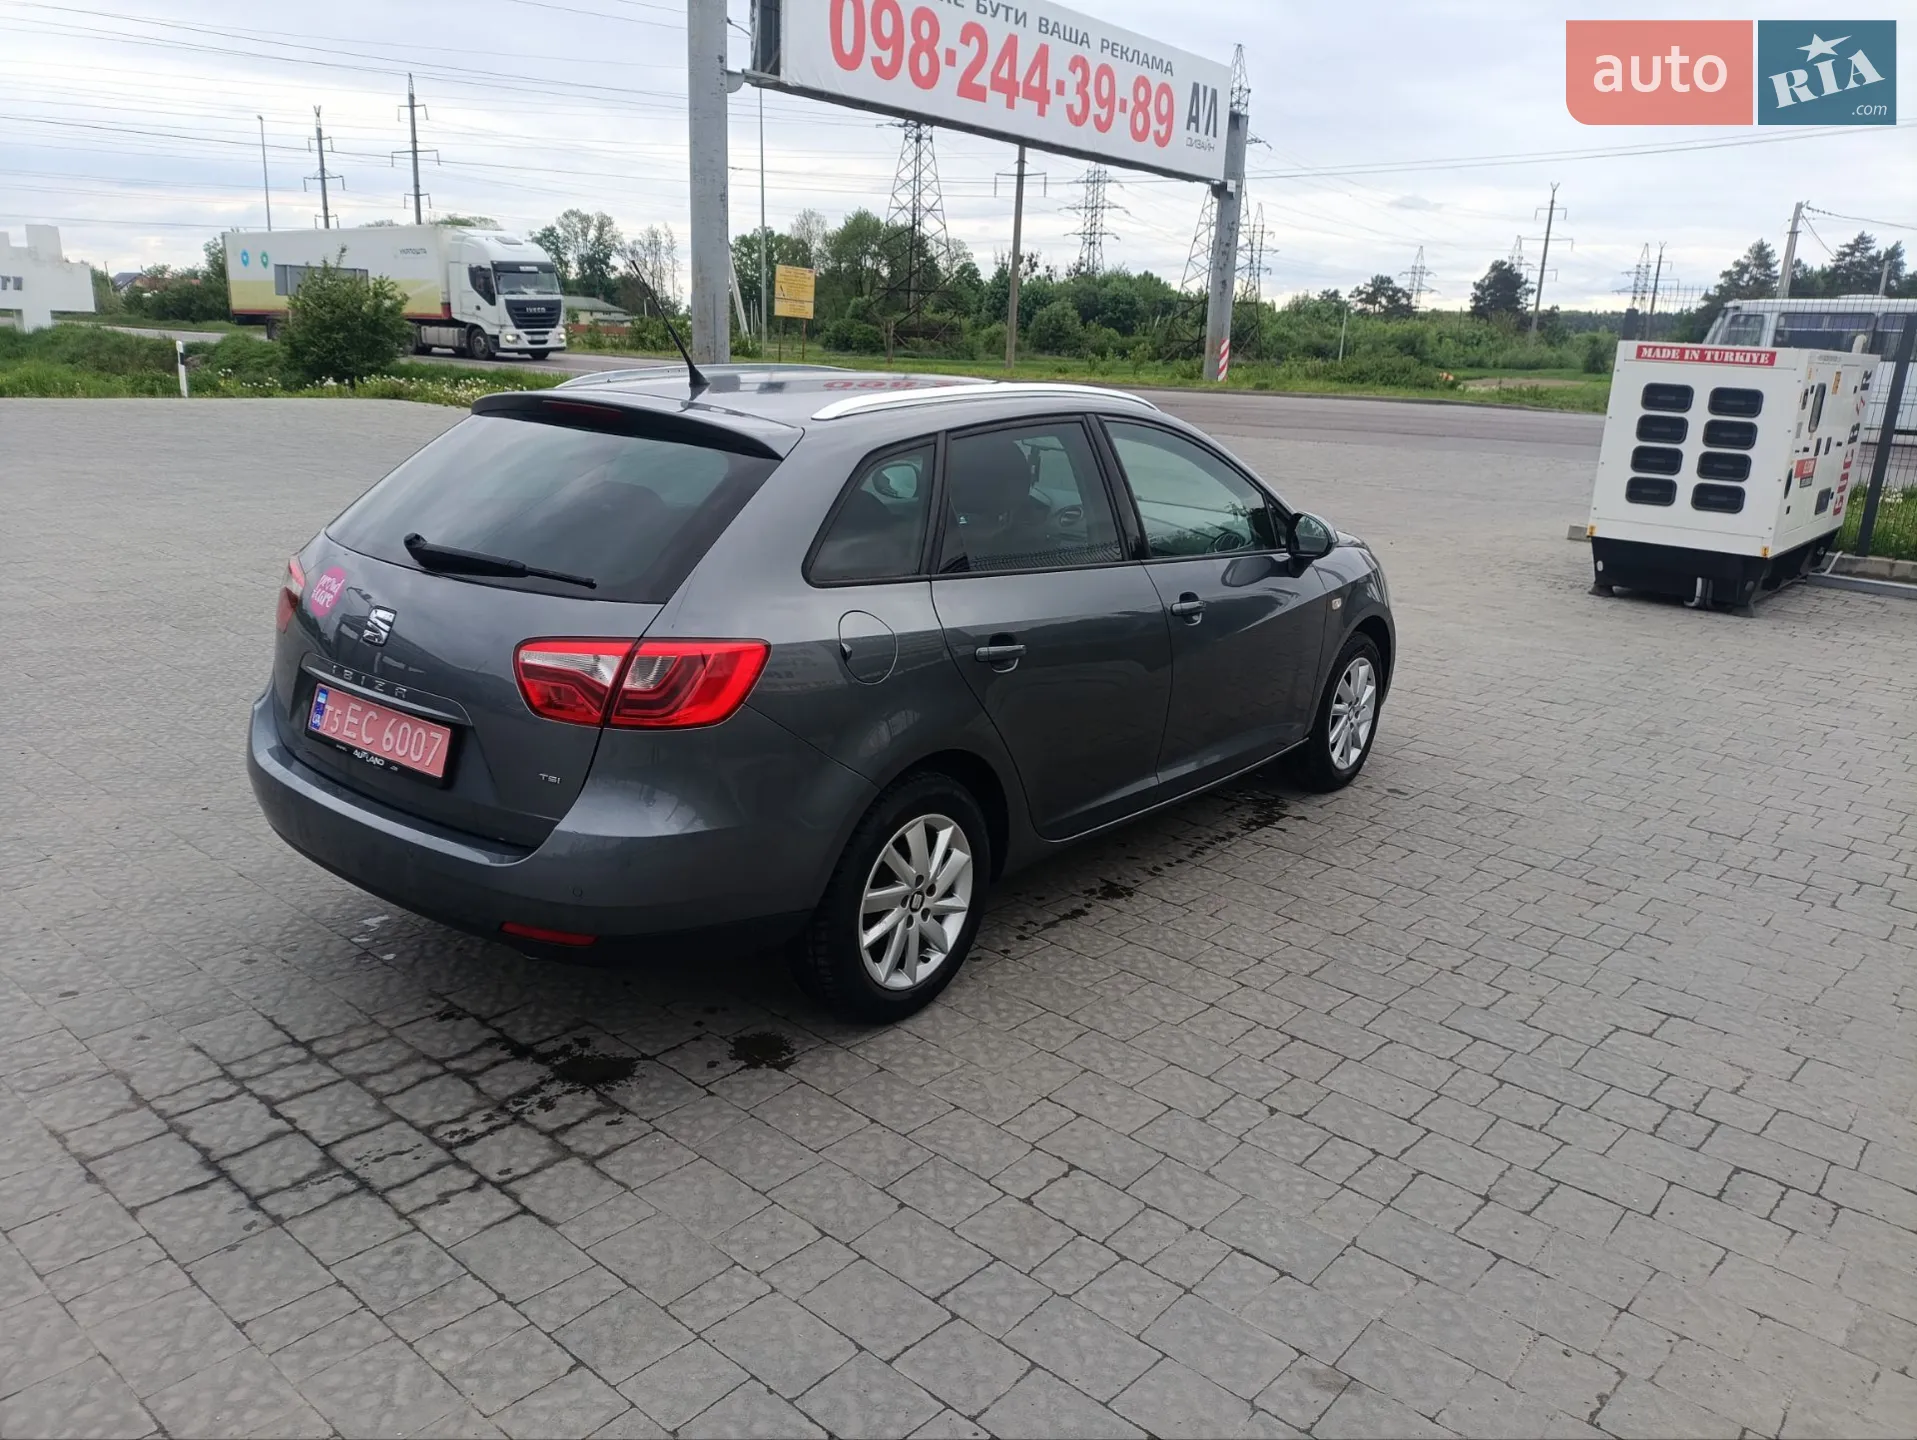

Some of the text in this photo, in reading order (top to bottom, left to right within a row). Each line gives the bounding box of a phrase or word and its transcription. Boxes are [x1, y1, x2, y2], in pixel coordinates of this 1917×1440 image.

[975, 0, 1174, 77] БУТИ ВАША РЕКЛАМА
[1641, 347, 1680, 360] MADE
[1684, 348, 1701, 360] IN
[381, 718, 443, 767] 6007
[538, 773, 561, 785] TSI
